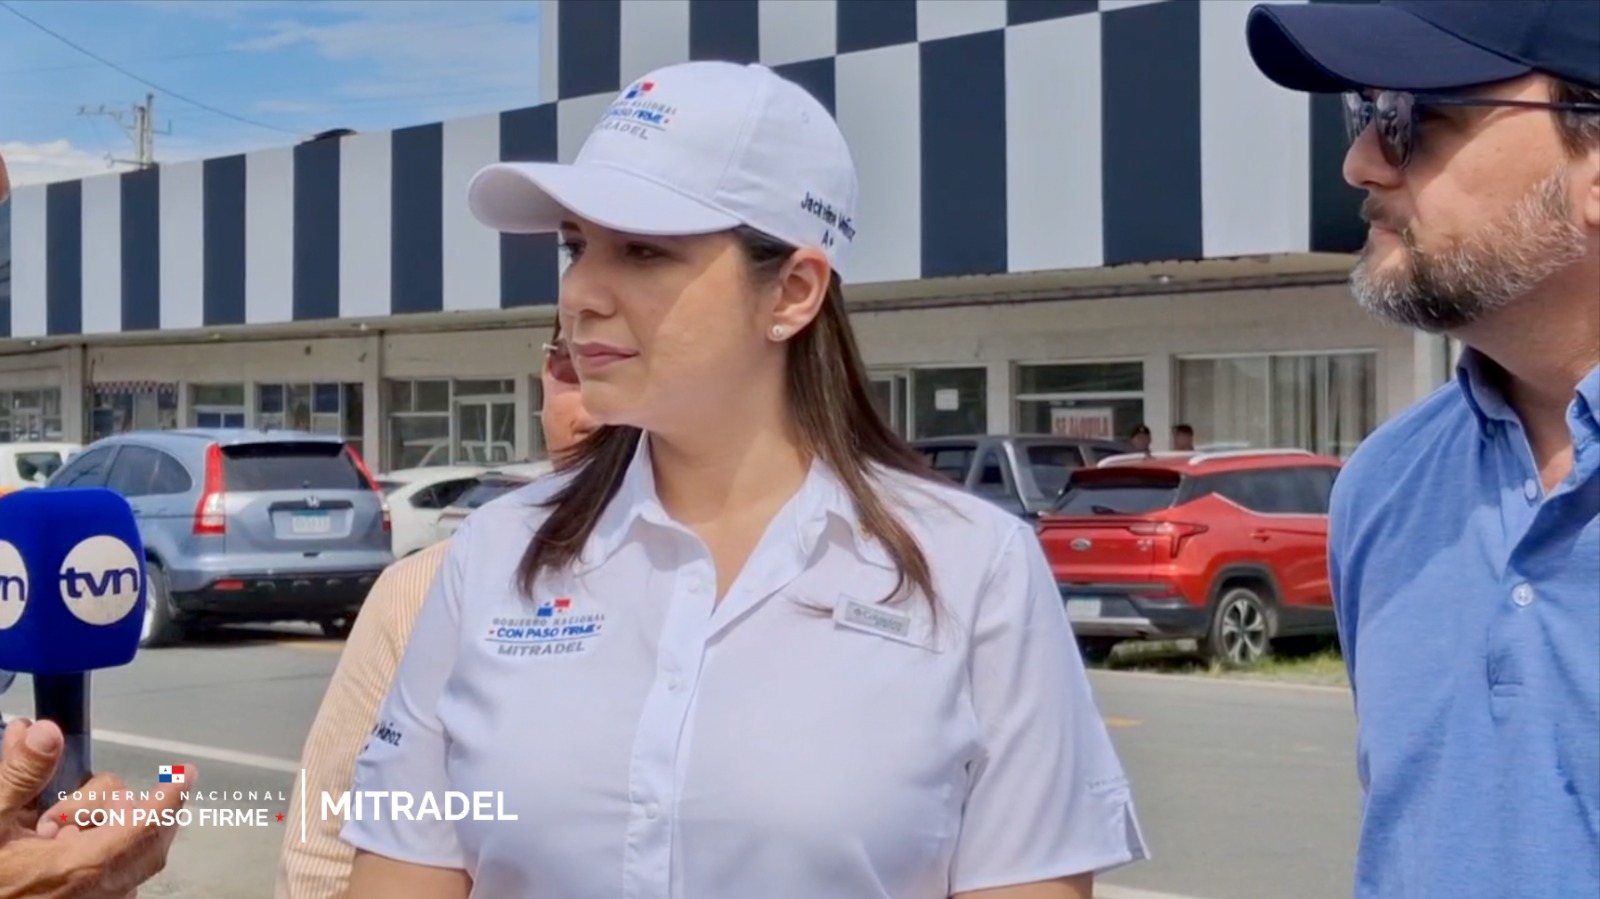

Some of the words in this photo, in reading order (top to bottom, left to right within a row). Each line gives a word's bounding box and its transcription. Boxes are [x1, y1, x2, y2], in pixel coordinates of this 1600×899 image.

[60, 567, 138, 598] tvn
[493, 617, 547, 627] GOBIERNO
[553, 613, 605, 626] NACIONAL
[497, 627, 523, 639] CON
[525, 626, 559, 639] PASO
[561, 624, 596, 636] FIRME
[497, 640, 585, 657] MITRADEL
